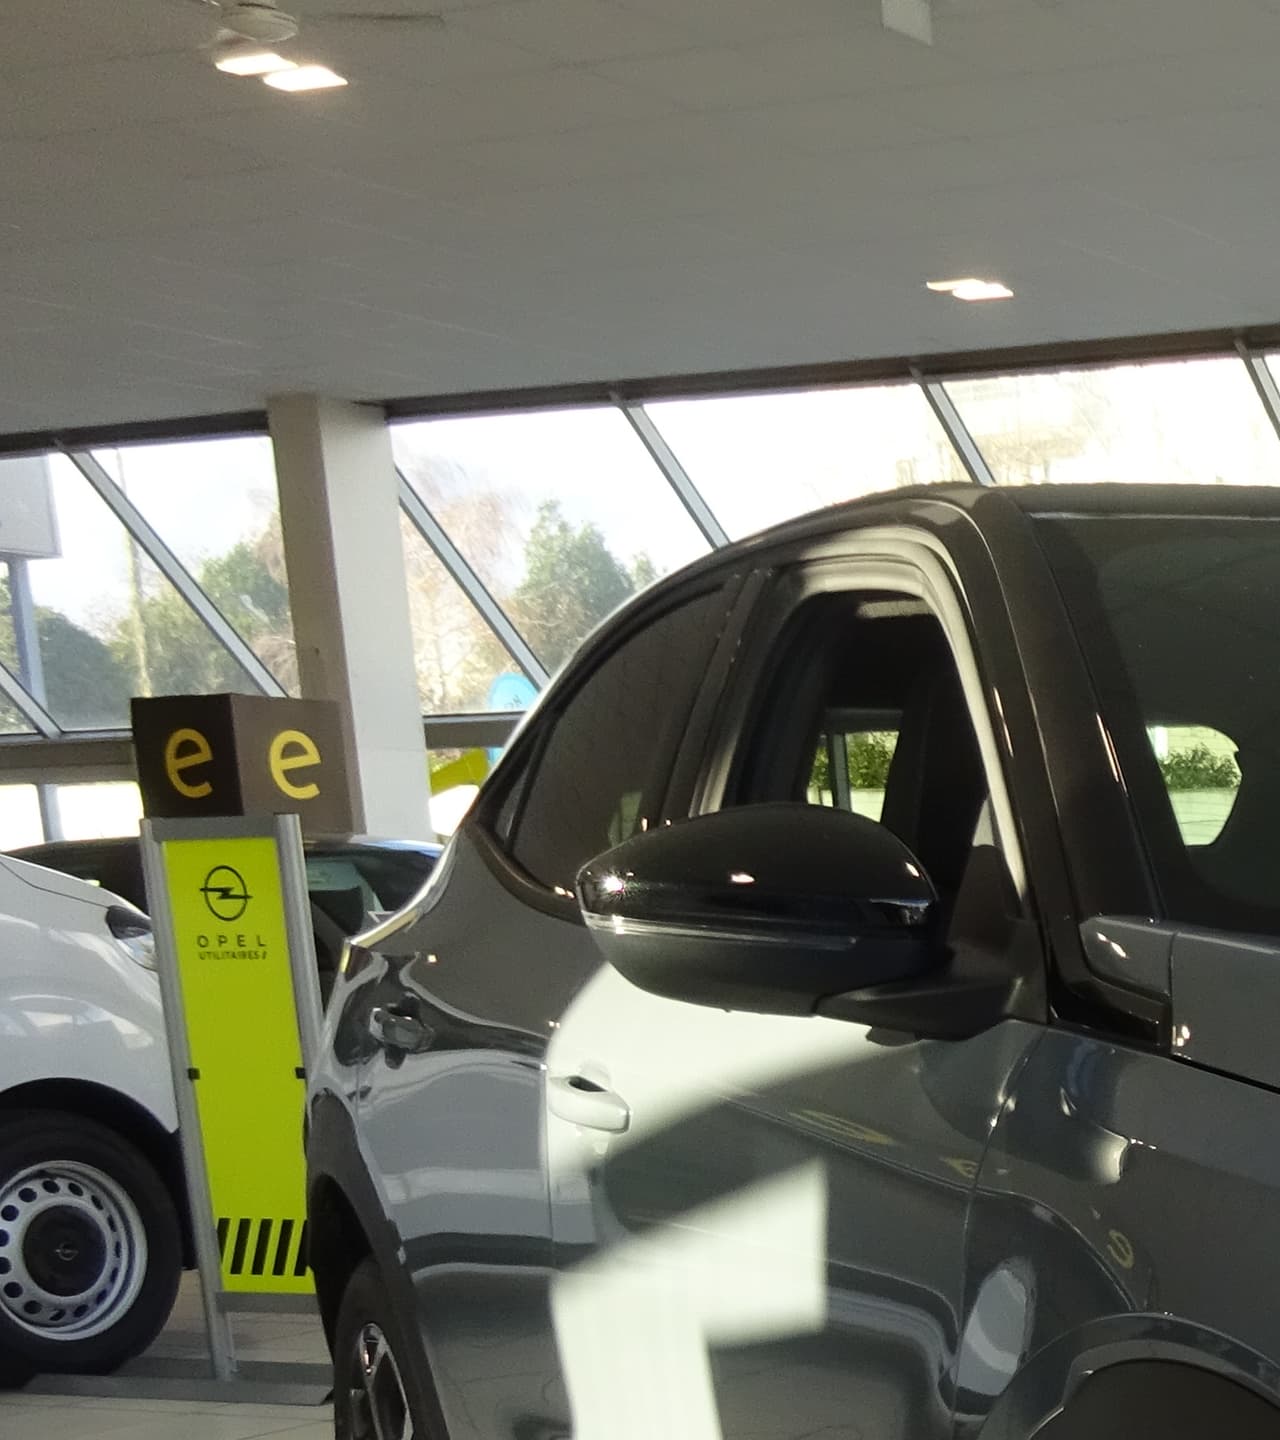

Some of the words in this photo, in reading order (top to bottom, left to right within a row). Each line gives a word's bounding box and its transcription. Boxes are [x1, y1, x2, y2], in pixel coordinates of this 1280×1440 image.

[165, 728, 214, 798] e
[269, 729, 322, 799] e
[197, 934, 267, 948] OPEL
